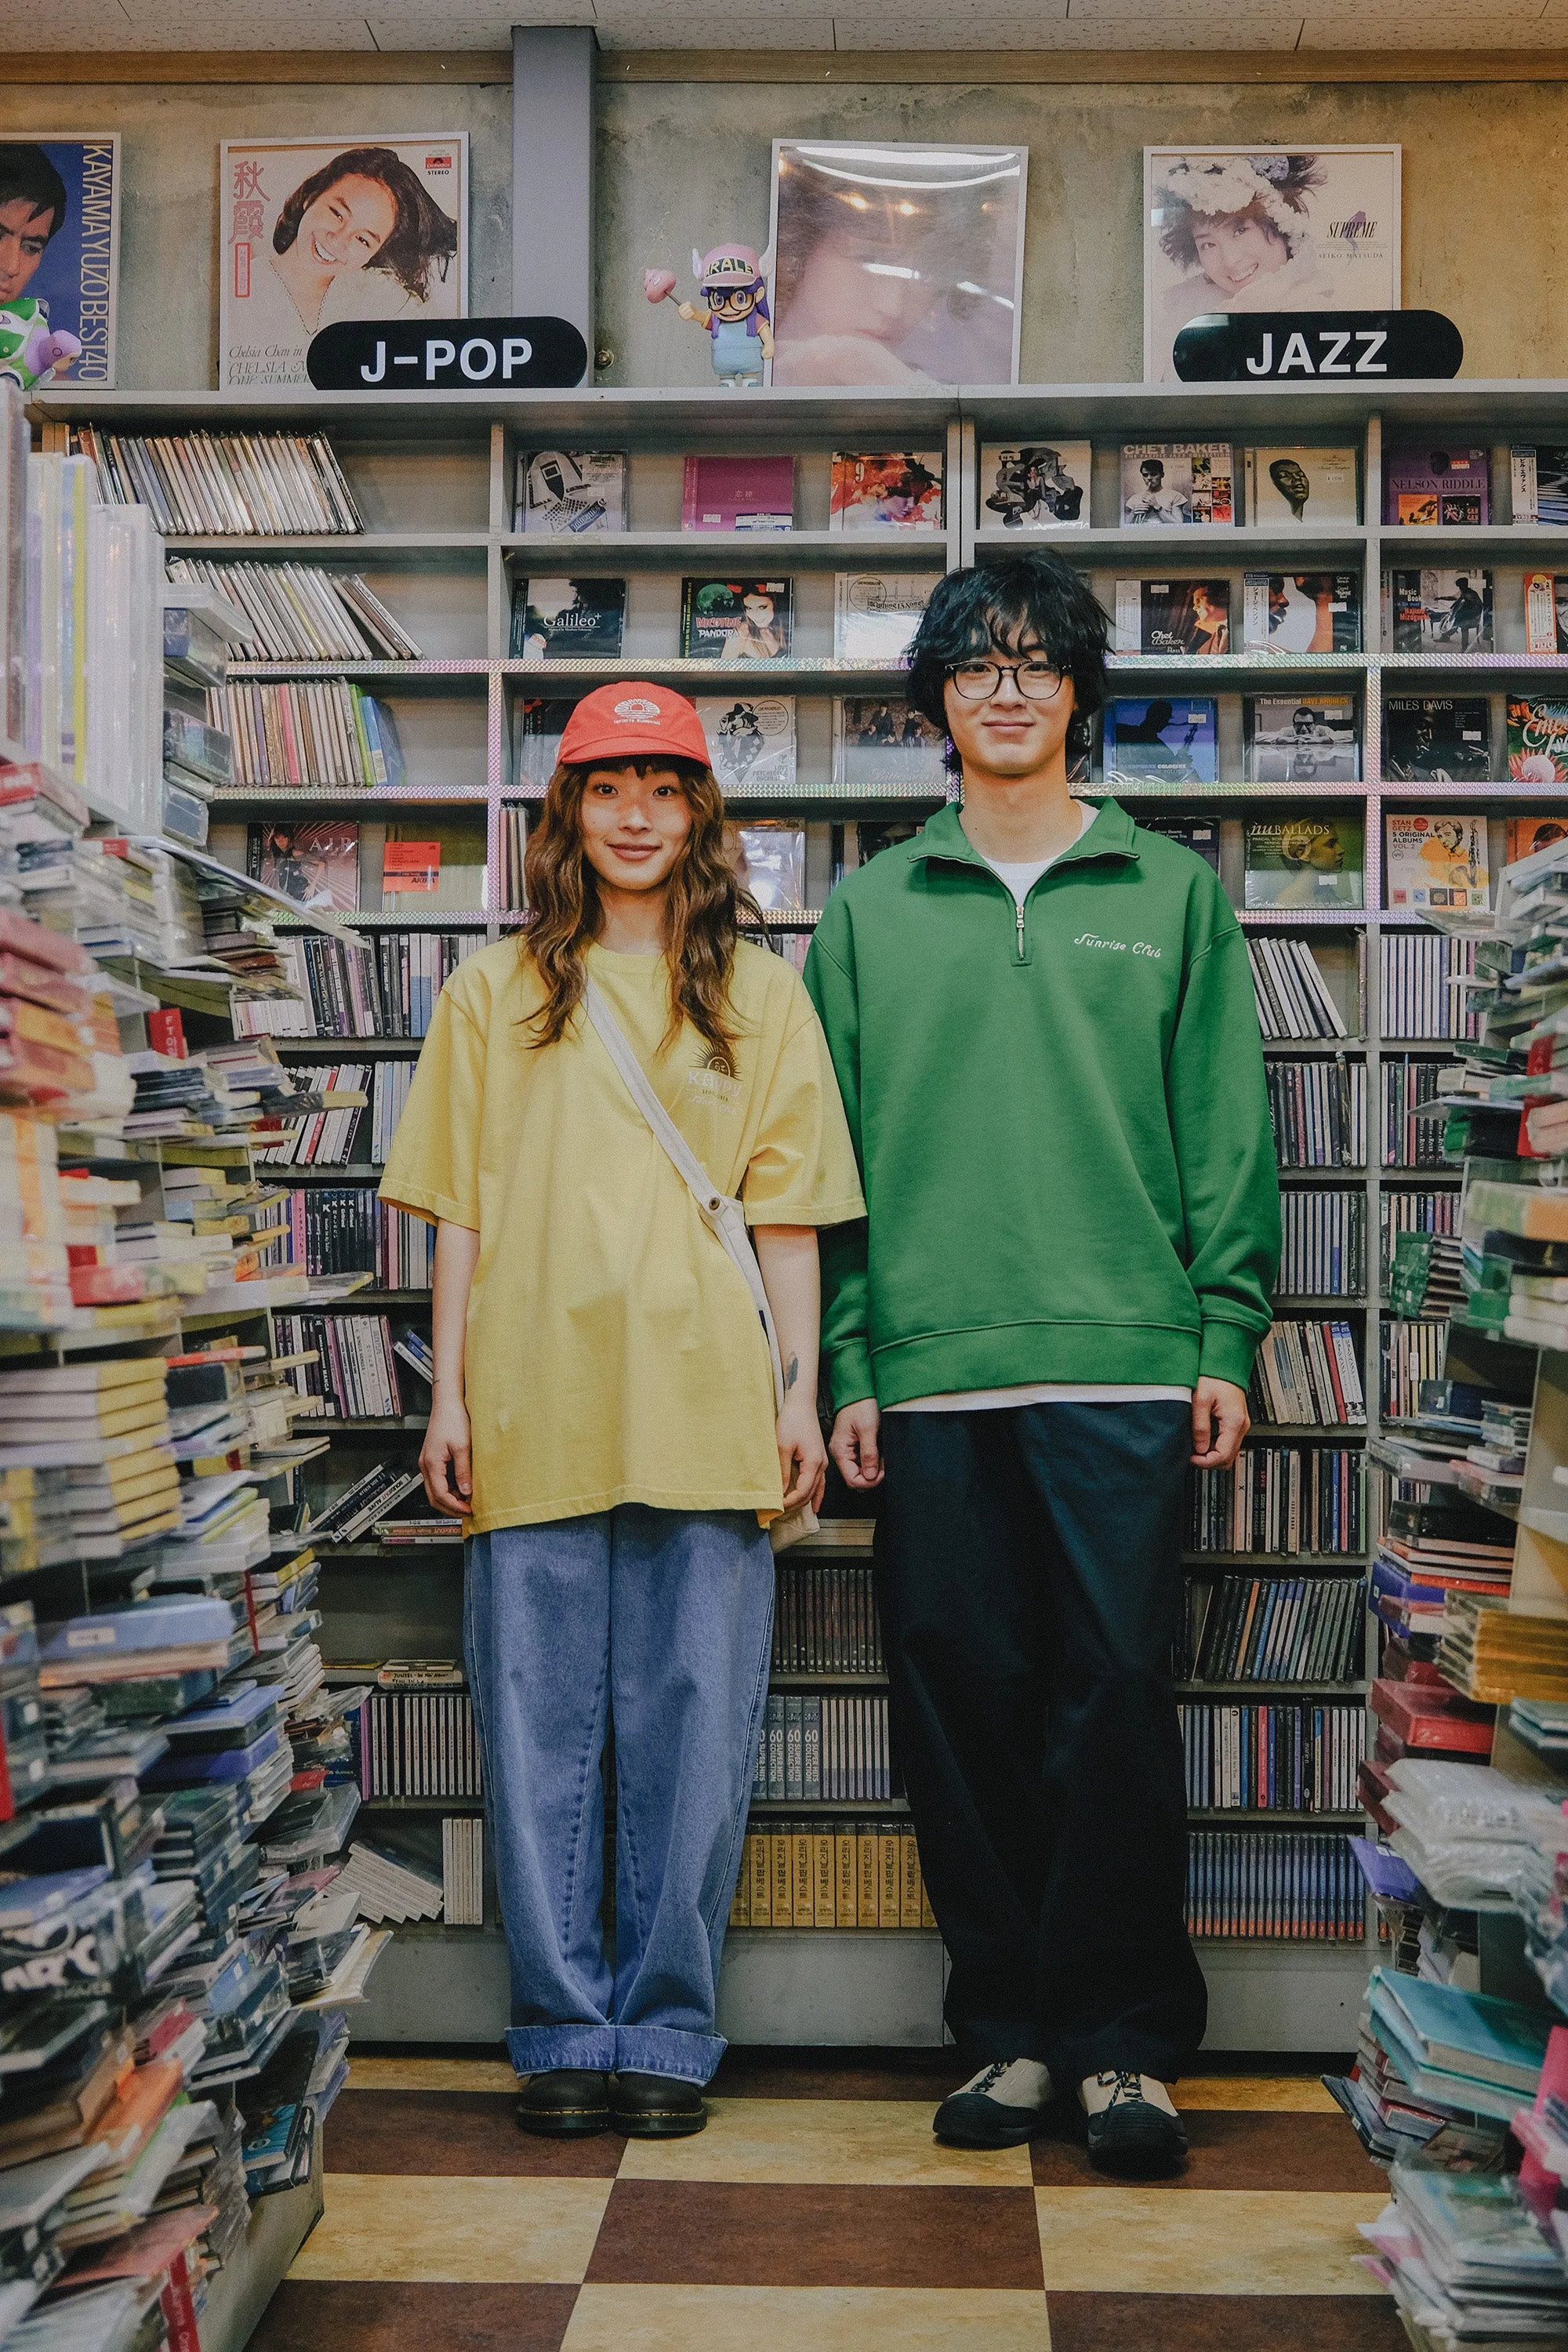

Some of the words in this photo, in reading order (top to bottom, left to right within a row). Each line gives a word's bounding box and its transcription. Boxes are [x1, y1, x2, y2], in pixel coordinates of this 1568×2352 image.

[82, 144, 111, 236] KAYAMA
[1327, 221, 1377, 238] SUPREME
[80, 238, 110, 296] YUZO
[79, 300, 108, 349] BEST
[230, 346, 261, 358] Chelsia
[265, 345, 290, 358] Chan
[293, 346, 303, 356] in
[1247, 331, 1388, 376] JAZZ
[78, 350, 107, 381] 40
[361, 338, 532, 383] J-POP
[1123, 443, 1168, 455] CHET
[1173, 442, 1230, 455] BAKER
[855, 462, 865, 482] 9
[1392, 479, 1438, 489] NELSON
[1443, 478, 1486, 489] RIDDLE
[698, 629, 738, 638] PANDORA
[1151, 630, 1173, 640] Chet
[1388, 700, 1419, 710] MILES
[1423, 699, 1453, 710] DAVIS
[1074, 933, 1127, 950] Sunrise
[1132, 942, 1161, 958] Club
[770, 1730, 783, 1743] 60
[787, 1730, 801, 1743] 60
[805, 1730, 818, 1743] 60
